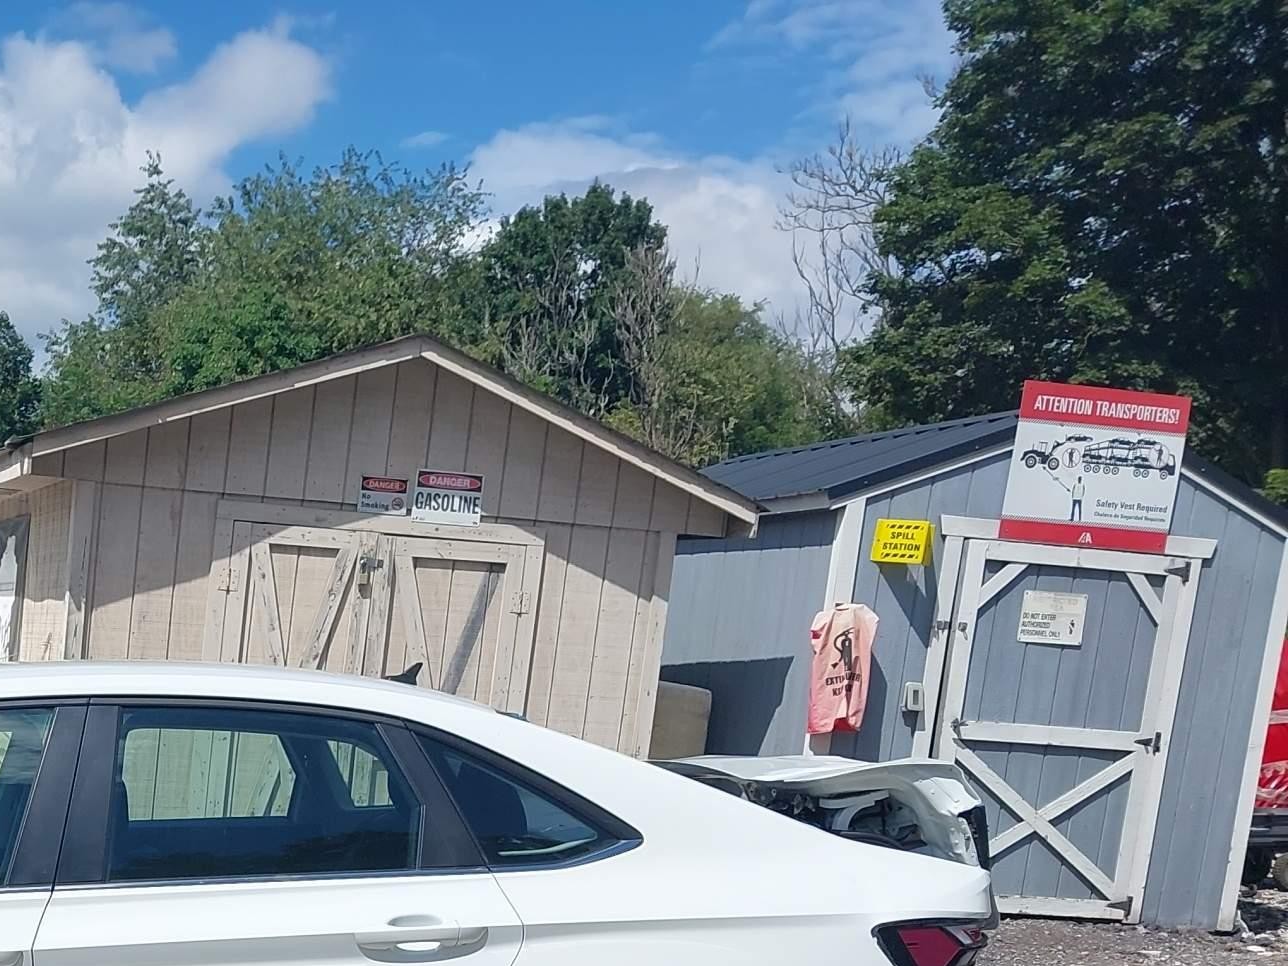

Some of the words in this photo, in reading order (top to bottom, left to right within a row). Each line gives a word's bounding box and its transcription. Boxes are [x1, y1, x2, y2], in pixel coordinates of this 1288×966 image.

[1034, 395, 1093, 415] ATTENTION
[1096, 401, 1180, 424] TRANSPORTERS!
[369, 480, 400, 489] DANGER
[429, 476, 470, 488] DANGER
[361, 501, 389, 511] Smoking
[415, 492, 480, 514] GASOLINE
[1096, 499, 1119, 511] Safety
[1120, 501, 1135, 511] Vest
[1136, 503, 1168, 513] Required
[890, 531, 916, 540] SPILL
[882, 542, 921, 551] STATION
